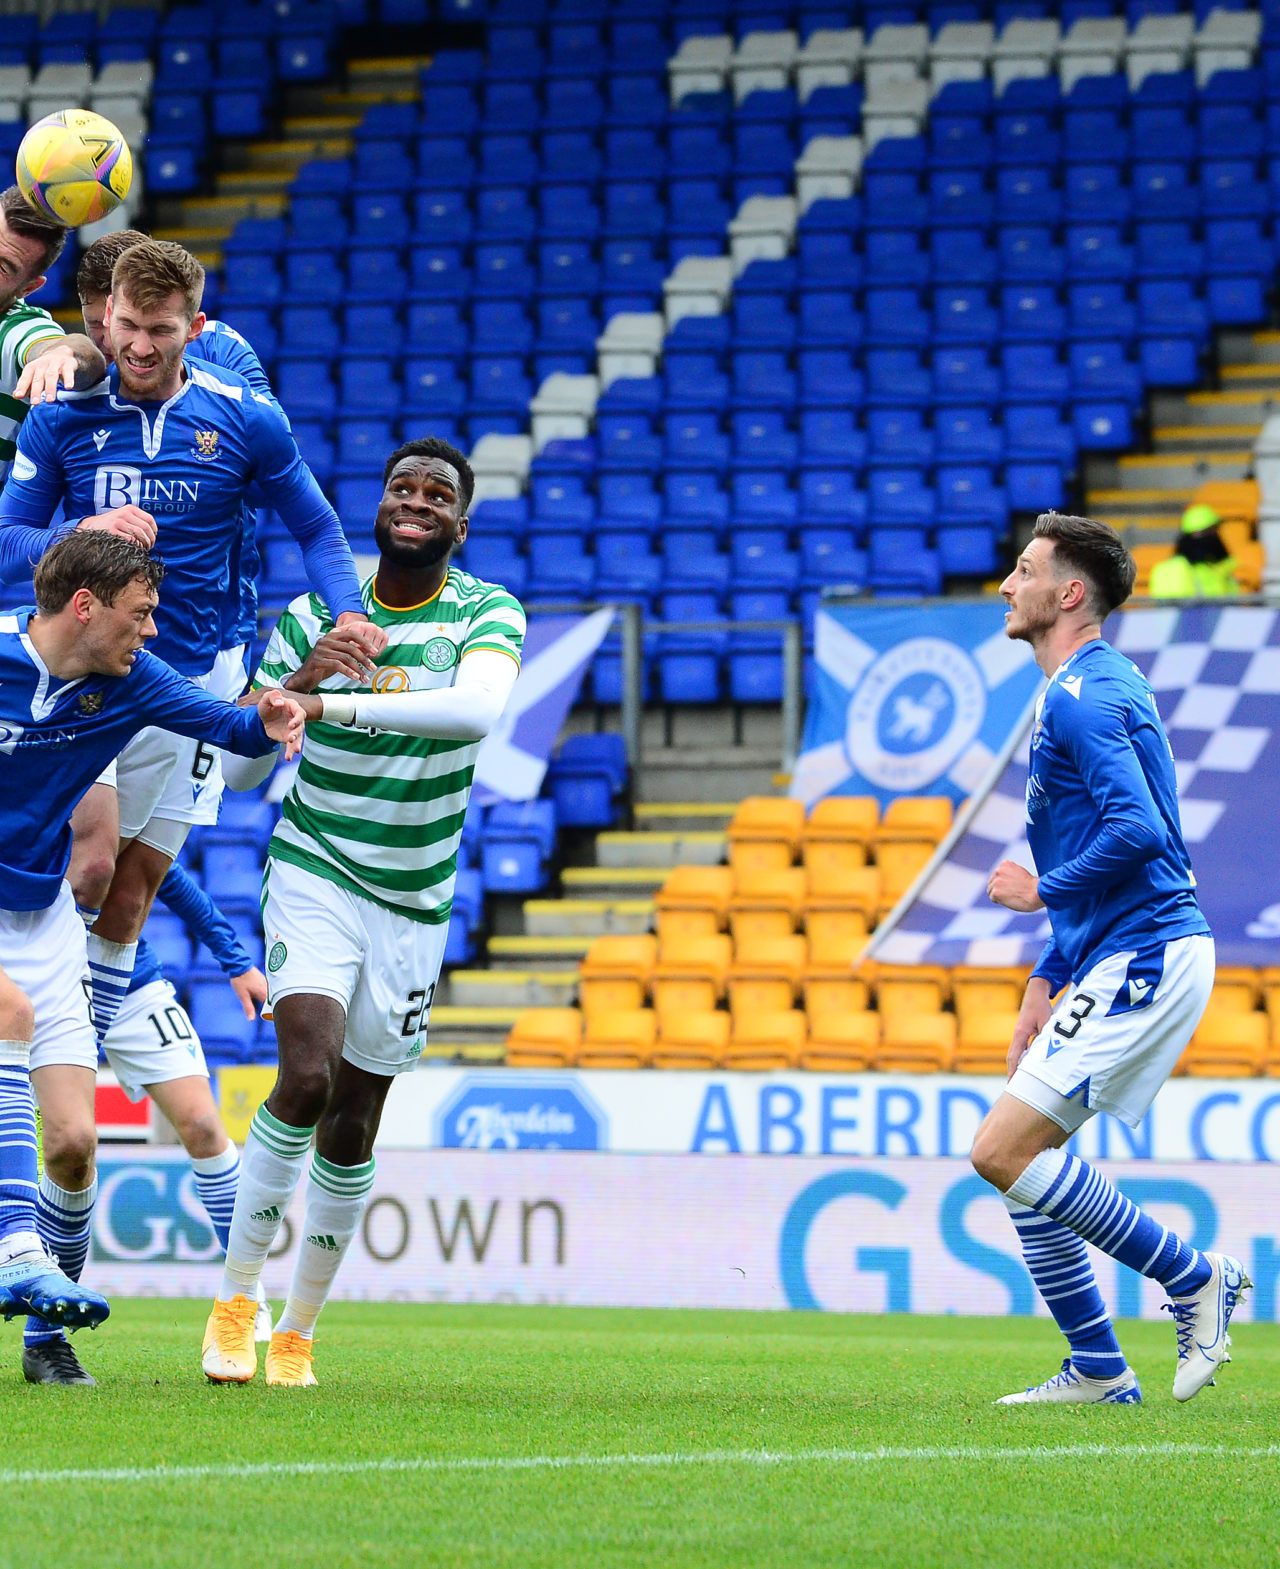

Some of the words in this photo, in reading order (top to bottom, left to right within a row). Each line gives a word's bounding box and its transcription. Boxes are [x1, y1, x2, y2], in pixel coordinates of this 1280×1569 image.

[102, 471, 200, 509] BINN
[142, 503, 196, 513] GROUP
[148, 1006, 192, 1048] 10
[1053, 993, 1096, 1039] 3
[307, 1236, 340, 1252] adidas
